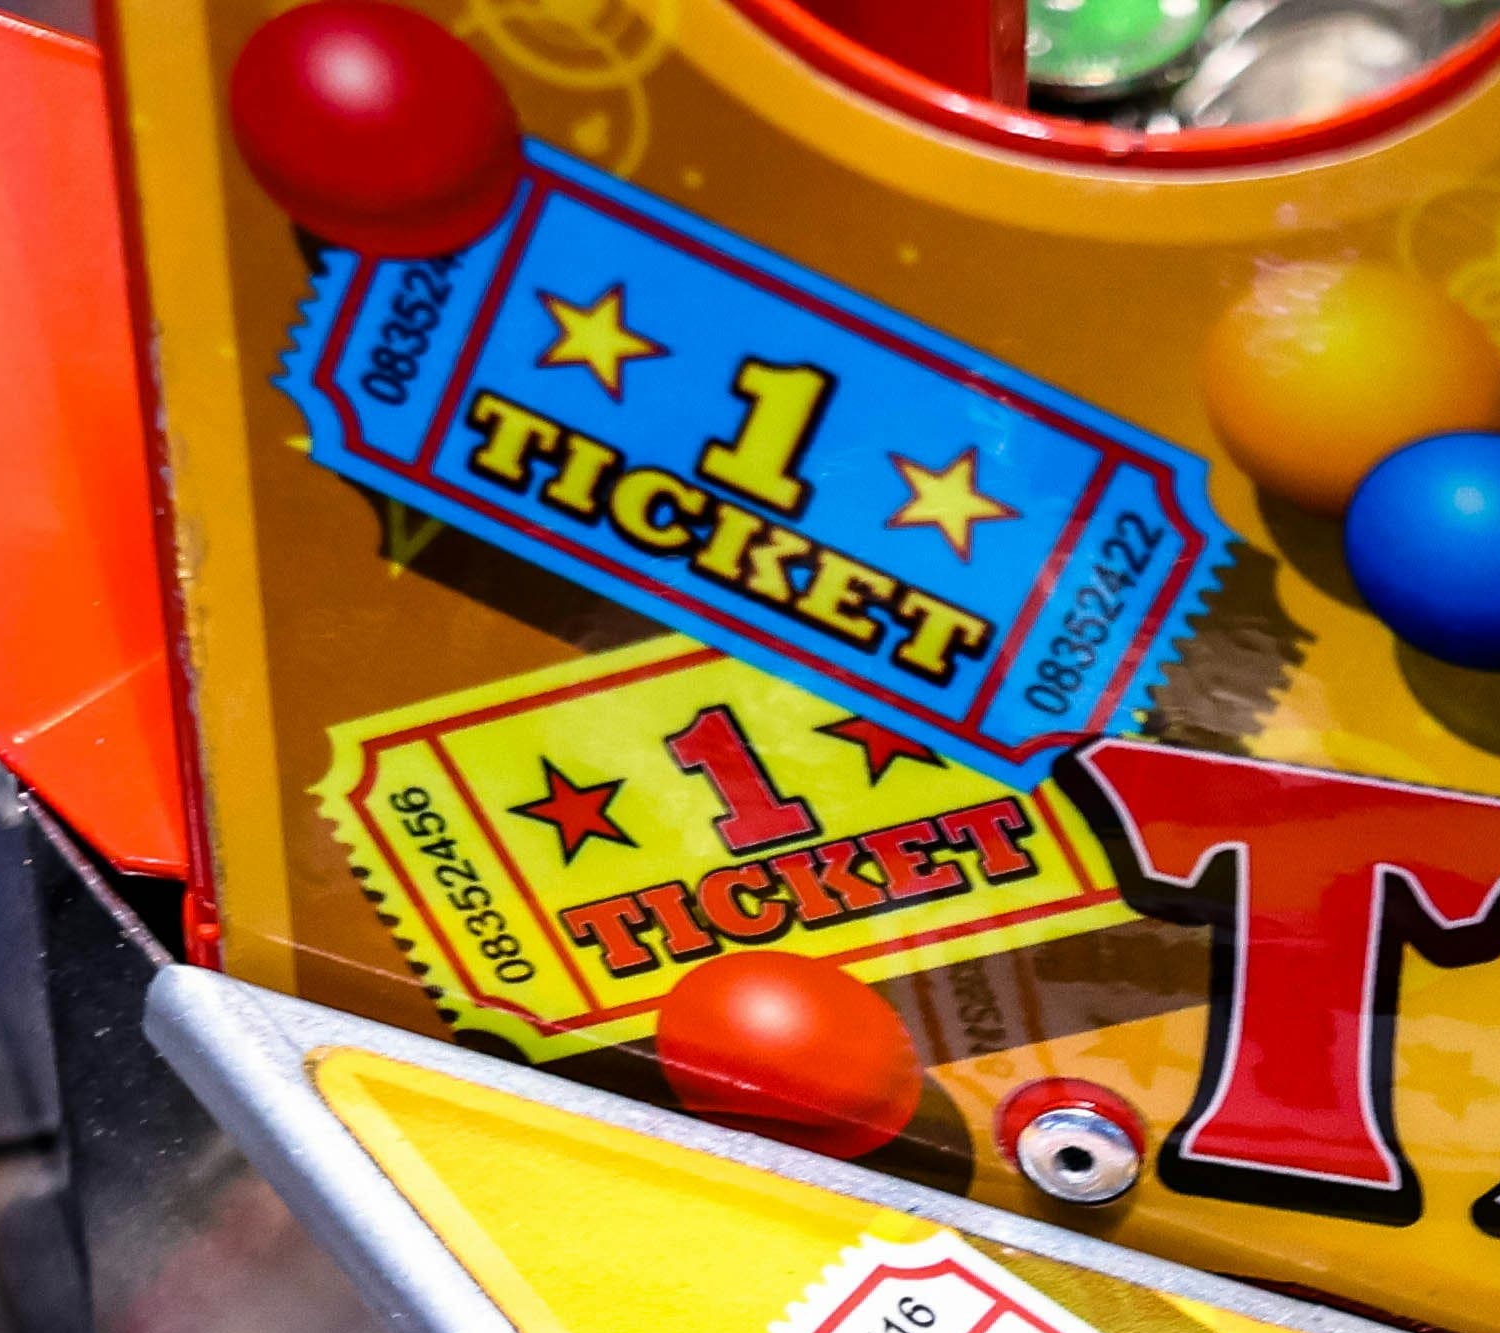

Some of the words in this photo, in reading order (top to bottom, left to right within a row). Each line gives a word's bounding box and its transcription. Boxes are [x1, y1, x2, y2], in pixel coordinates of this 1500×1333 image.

[359, 250, 464, 406] 083524
[699, 354, 837, 521] 1
[466, 388, 992, 685] TICKET
[1023, 509, 1168, 717] 08352422
[666, 703, 823, 857] 1
[390, 785, 536, 985] 08352456
[561, 796, 1037, 979] TICKET
